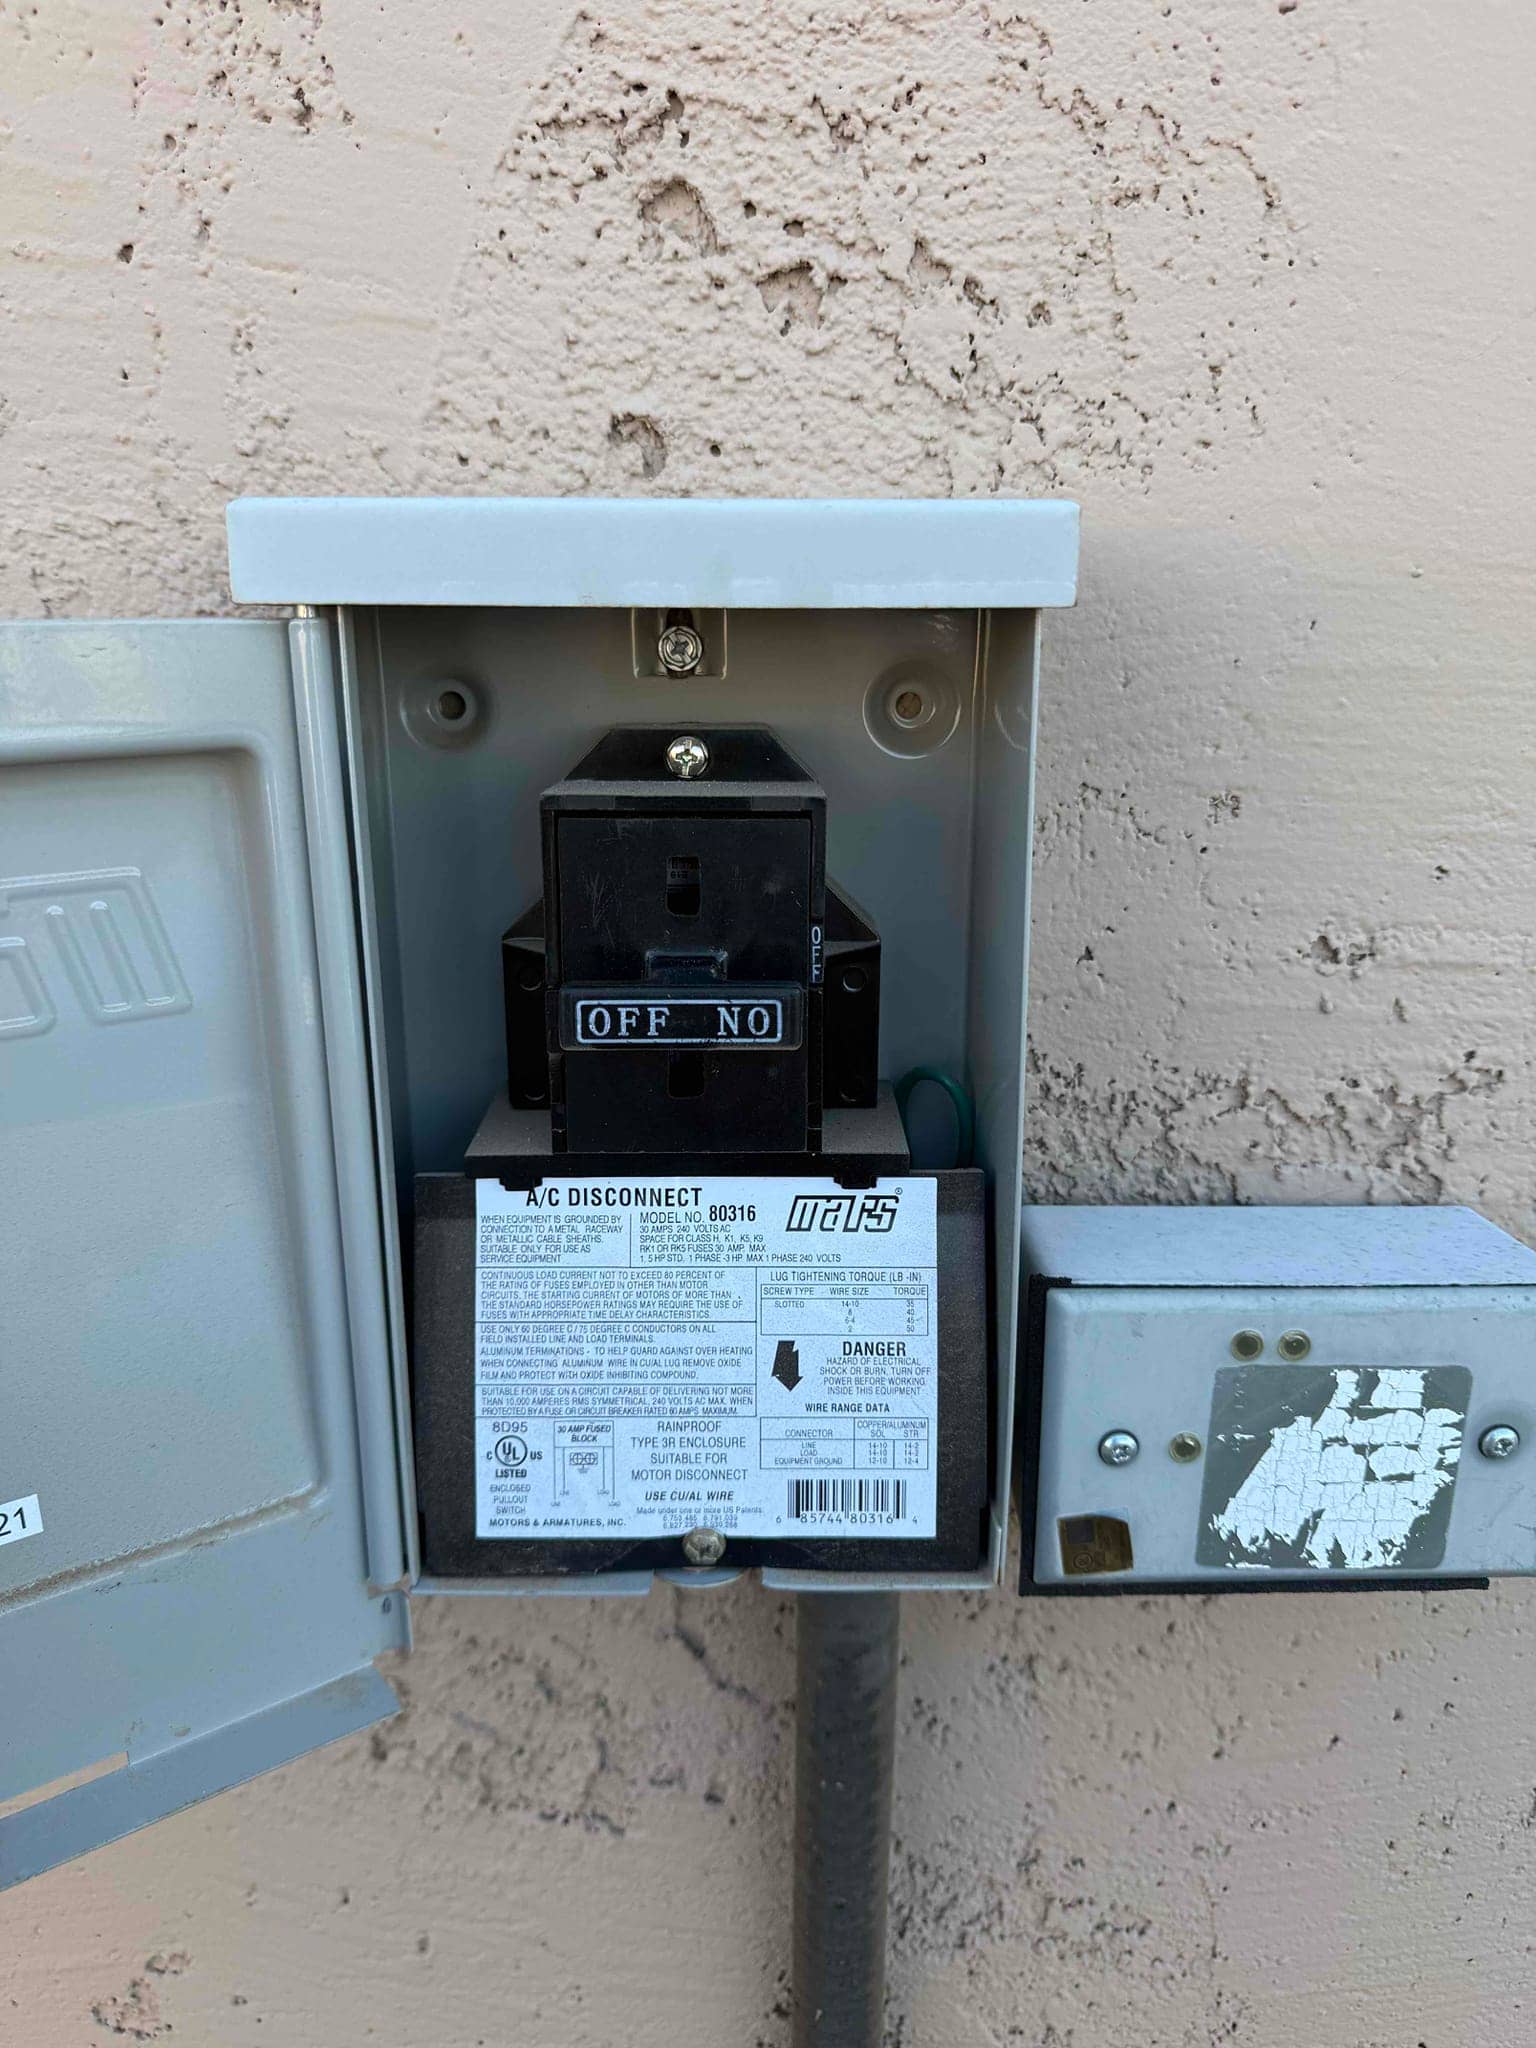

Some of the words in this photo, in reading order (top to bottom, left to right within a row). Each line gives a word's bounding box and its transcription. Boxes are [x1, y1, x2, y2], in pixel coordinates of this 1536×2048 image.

[588, 1007, 670, 1036] OFF
[526, 1187, 560, 1207] A/C
[568, 1187, 703, 1207] DISCONNECT
[639, 1212, 683, 1224] MODEL
[684, 1212, 705, 1224] NO.
[709, 1205, 757, 1222] 80316
[480, 1215, 505, 1224] WHEN
[506, 1215, 551, 1224] EQUIPMENT
[554, 1215, 561, 1224] IS
[564, 1215, 610, 1224] GROUNDED
[611, 1215, 621, 1224] BY
[480, 1225, 532, 1233] CONNECTION
[535, 1225, 545, 1233] TO
[555, 1225, 579, 1233] METAL
[585, 1225, 623, 1233] RACEWAY
[639, 1225, 649, 1233] 30
[651, 1225, 673, 1233] AMPS
[676, 1225, 690, 1233] 240
[693, 1225, 719, 1233] VOLTS
[719, 1225, 731, 1233] AC
[480, 1235, 492, 1243] OR
[496, 1235, 533, 1243] METALLIC
[536, 1235, 562, 1243] CABLE
[639, 1234, 666, 1243] SPACE
[667, 1234, 684, 1243] FOR
[685, 1234, 712, 1243] CLASS
[480, 1245, 517, 1253] SUITABLE
[520, 1245, 542, 1253] ONLY
[545, 1245, 561, 1253] FOR
[563, 1245, 579, 1253] USE
[580, 1245, 591, 1253] AS
[480, 1254, 514, 1263] SERVICE
[516, 1254, 562, 1263] EQUIPMENT
[480, 1271, 534, 1280] CONTINUOUS
[536, 1271, 558, 1280] LOAD
[559, 1271, 597, 1280] CURRENT
[599, 1271, 616, 1280] NOT
[618, 1271, 628, 1280] TO
[630, 1271, 662, 1280] EXCEED
[675, 1271, 712, 1280] PERCENT
[714, 1271, 726, 1280] OF
[770, 1271, 788, 1283] LUG
[792, 1271, 846, 1283] TIGHTENING
[849, 1271, 886, 1283] TORQUE
[480, 1281, 497, 1289] THE
[499, 1281, 528, 1289] RATING
[530, 1281, 541, 1289] OF
[543, 1281, 570, 1289] FUSES
[571, 1281, 615, 1289] EMPLOYED
[617, 1281, 625, 1289] IN
[627, 1281, 654, 1289] OTHER
[656, 1281, 677, 1289] THAN
[679, 1281, 708, 1289] MOTOR
[763, 1287, 792, 1296] SCREW
[794, 1287, 815, 1296] TYPE
[829, 1287, 849, 1296] WIRE
[852, 1287, 869, 1296] SIZE
[893, 1287, 926, 1296] TORQUE
[842, 1342, 906, 1356] DANGER
[826, 1357, 858, 1366] HAZARD
[860, 1357, 871, 1366] OF
[873, 1357, 921, 1366] ELECTRICAL
[819, 1367, 848, 1376] SHOCK
[850, 1367, 862, 1376] OR
[891, 1367, 913, 1376] TURN
[915, 1367, 931, 1376] OFF
[823, 1377, 852, 1386] POWER
[854, 1377, 885, 1386] BEFORE
[887, 1377, 925, 1386] WORKING
[827, 1386, 853, 1395] INSIDE
[856, 1386, 873, 1395] THIS
[875, 1386, 920, 1395] EQUIPMENT
[805, 1403, 828, 1413] WIRE
[831, 1403, 863, 1413] RANGE
[866, 1403, 890, 1413] DATA
[567, 1425, 585, 1433] AMP
[586, 1425, 612, 1433] FUSED
[657, 1420, 722, 1432] RAINPROOF
[571, 1434, 598, 1442] BLOCK
[785, 1429, 833, 1438] CONNECTOR
[630, 1437, 659, 1448] TYPE
[679, 1437, 747, 1448] ENCLOSURE
[502, 1441, 520, 1460] UL
[530, 1451, 543, 1460] US
[650, 1453, 702, 1464] SUITABLE
[705, 1453, 728, 1464] FOR
[495, 1468, 528, 1478] LISTED
[631, 1469, 672, 1480] MOTOR
[675, 1469, 749, 1480] DISCONNECT
[489, 1484, 531, 1492] ENCLOSED
[645, 1491, 666, 1501] USE
[670, 1491, 702, 1501] CU/AL
[707, 1491, 734, 1501] WIRE
[496, 1506, 526, 1515] SWITCH
[800, 1513, 843, 1524] 85744
[850, 1513, 894, 1524] 80316
[489, 1519, 531, 1528] MOTORS
[607, 1519, 626, 1528] INC.
